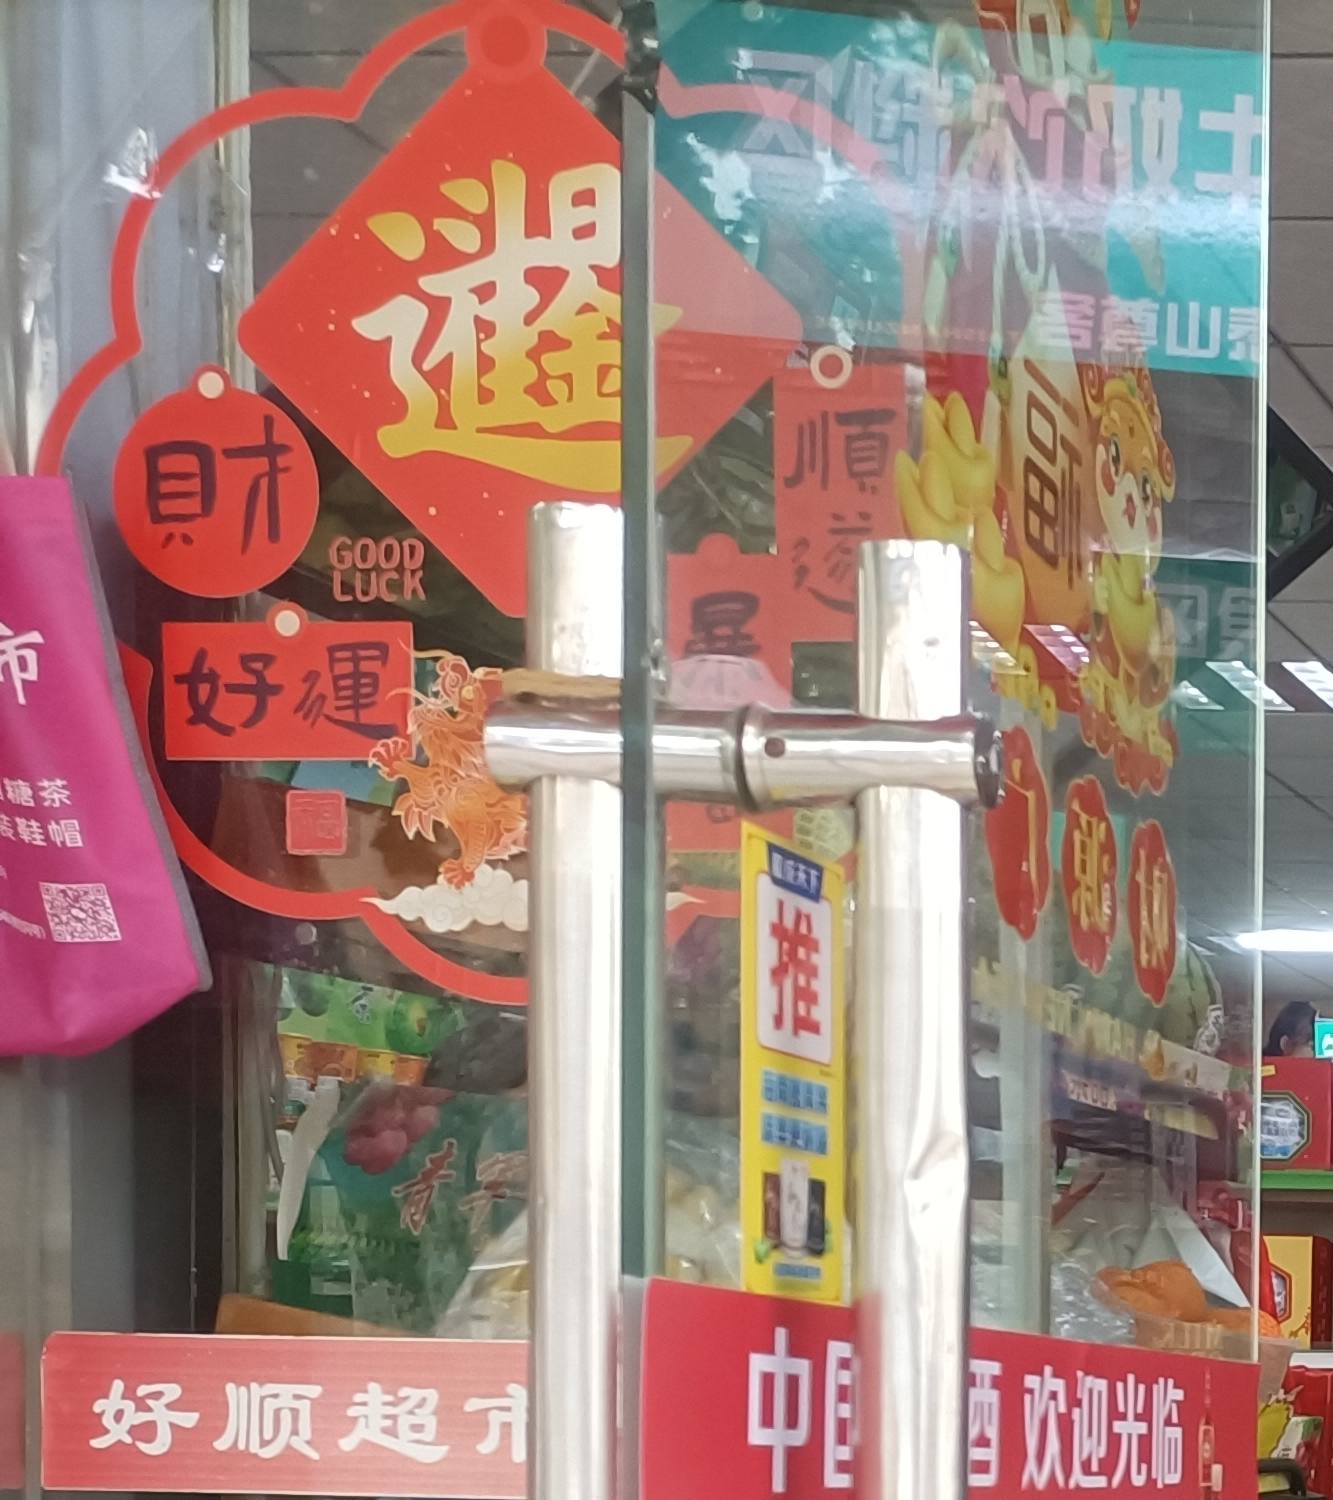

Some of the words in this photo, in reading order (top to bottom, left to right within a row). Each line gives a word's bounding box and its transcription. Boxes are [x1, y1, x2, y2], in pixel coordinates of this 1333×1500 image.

[145, 414, 293, 549] 財
[330, 537, 424, 571] GOOD
[333, 569, 427, 603] LUCK
[174, 641, 401, 738] 好運
[0, 777, 72, 808] 糖茶
[769, 897, 823, 1036] 推
[89, 1379, 530, 1463] 好顺超市
[1021, 1365, 1186, 1492] 欢迎光临
